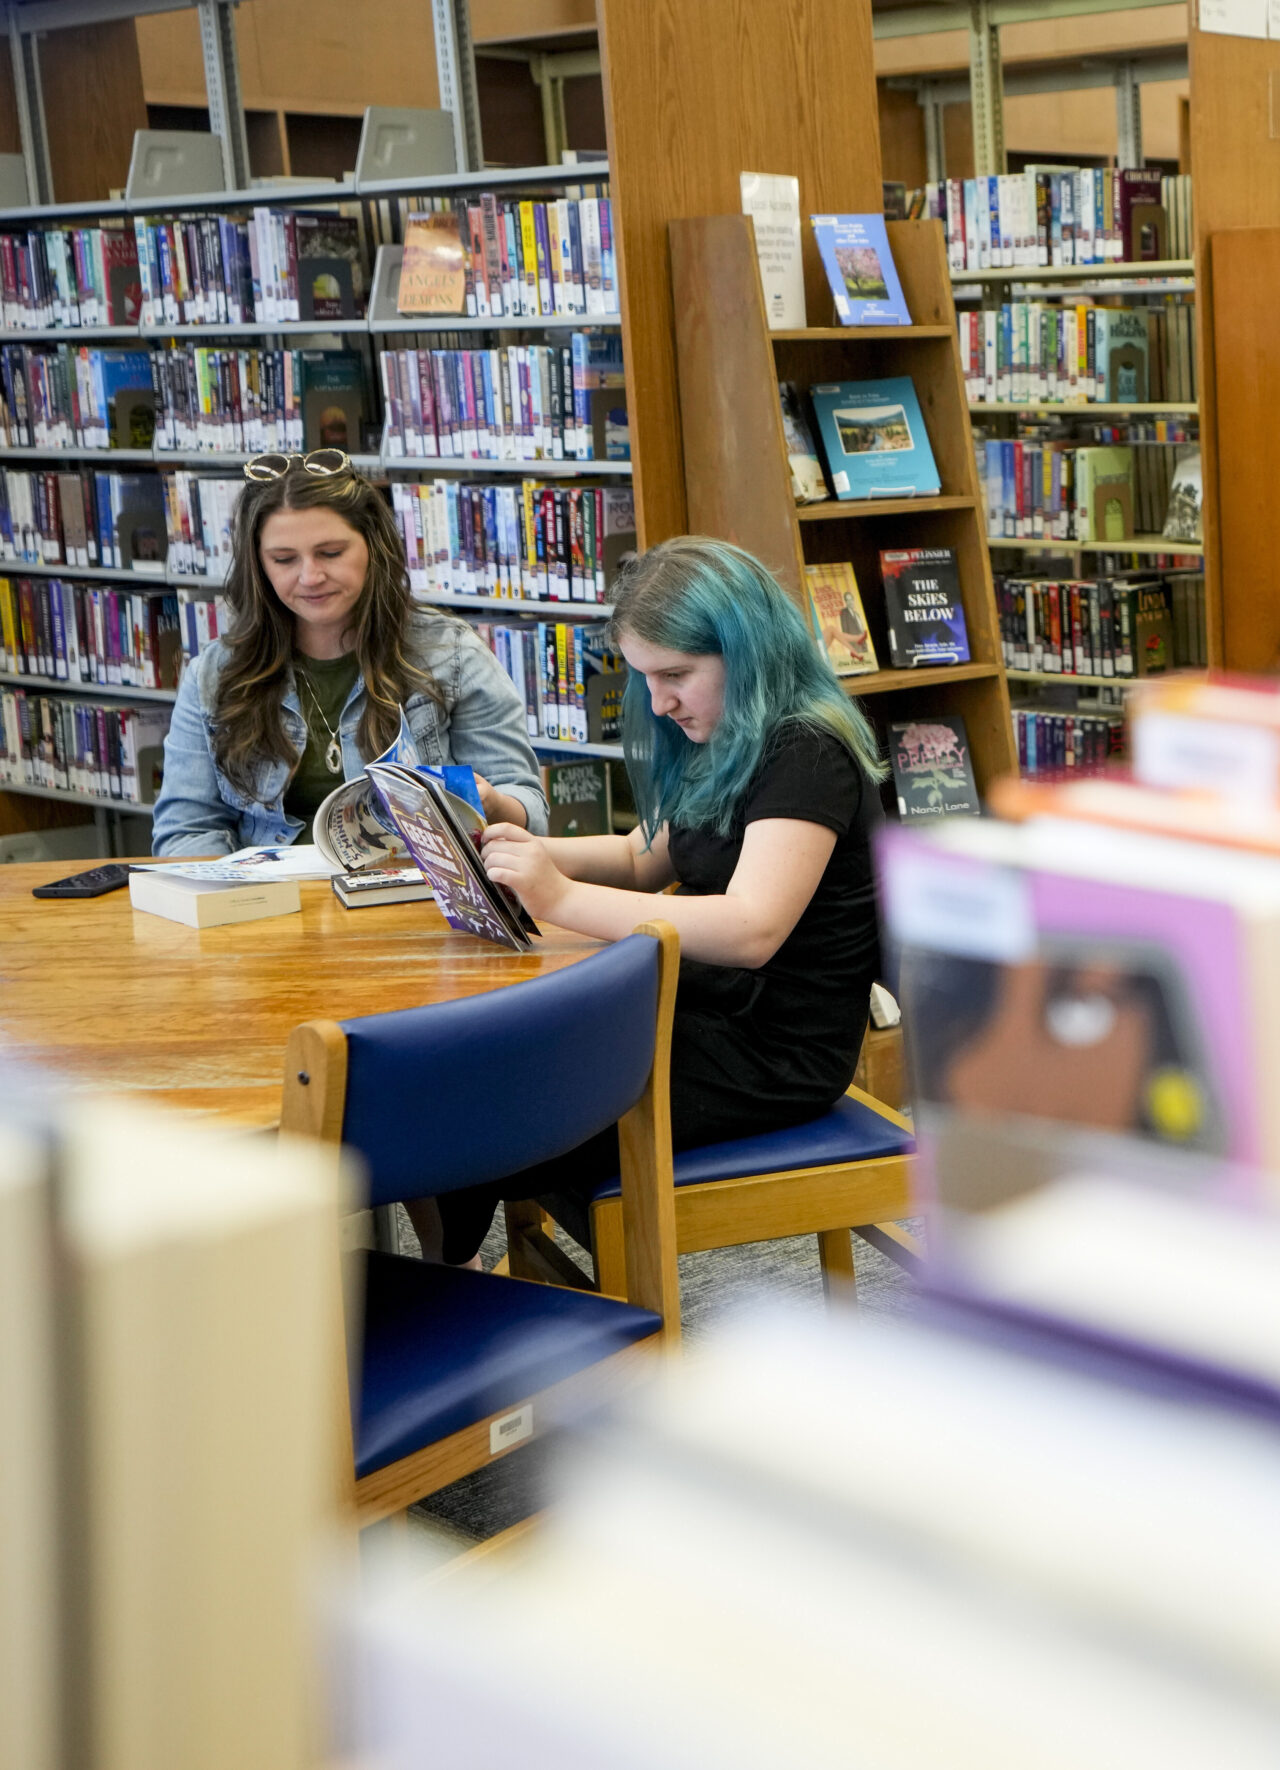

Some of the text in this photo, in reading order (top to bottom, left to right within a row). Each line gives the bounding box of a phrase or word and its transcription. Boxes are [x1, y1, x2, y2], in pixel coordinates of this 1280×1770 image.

[912, 579, 939, 591] THE
[903, 608, 954, 622] BELOW
[897, 746, 966, 768] PRETTY
[557, 766, 595, 783] CAROL
[553, 778, 602, 798] HIGGINS
[911, 801, 970, 815] Nancy Lane
[401, 820, 453, 859] GEEK'S
